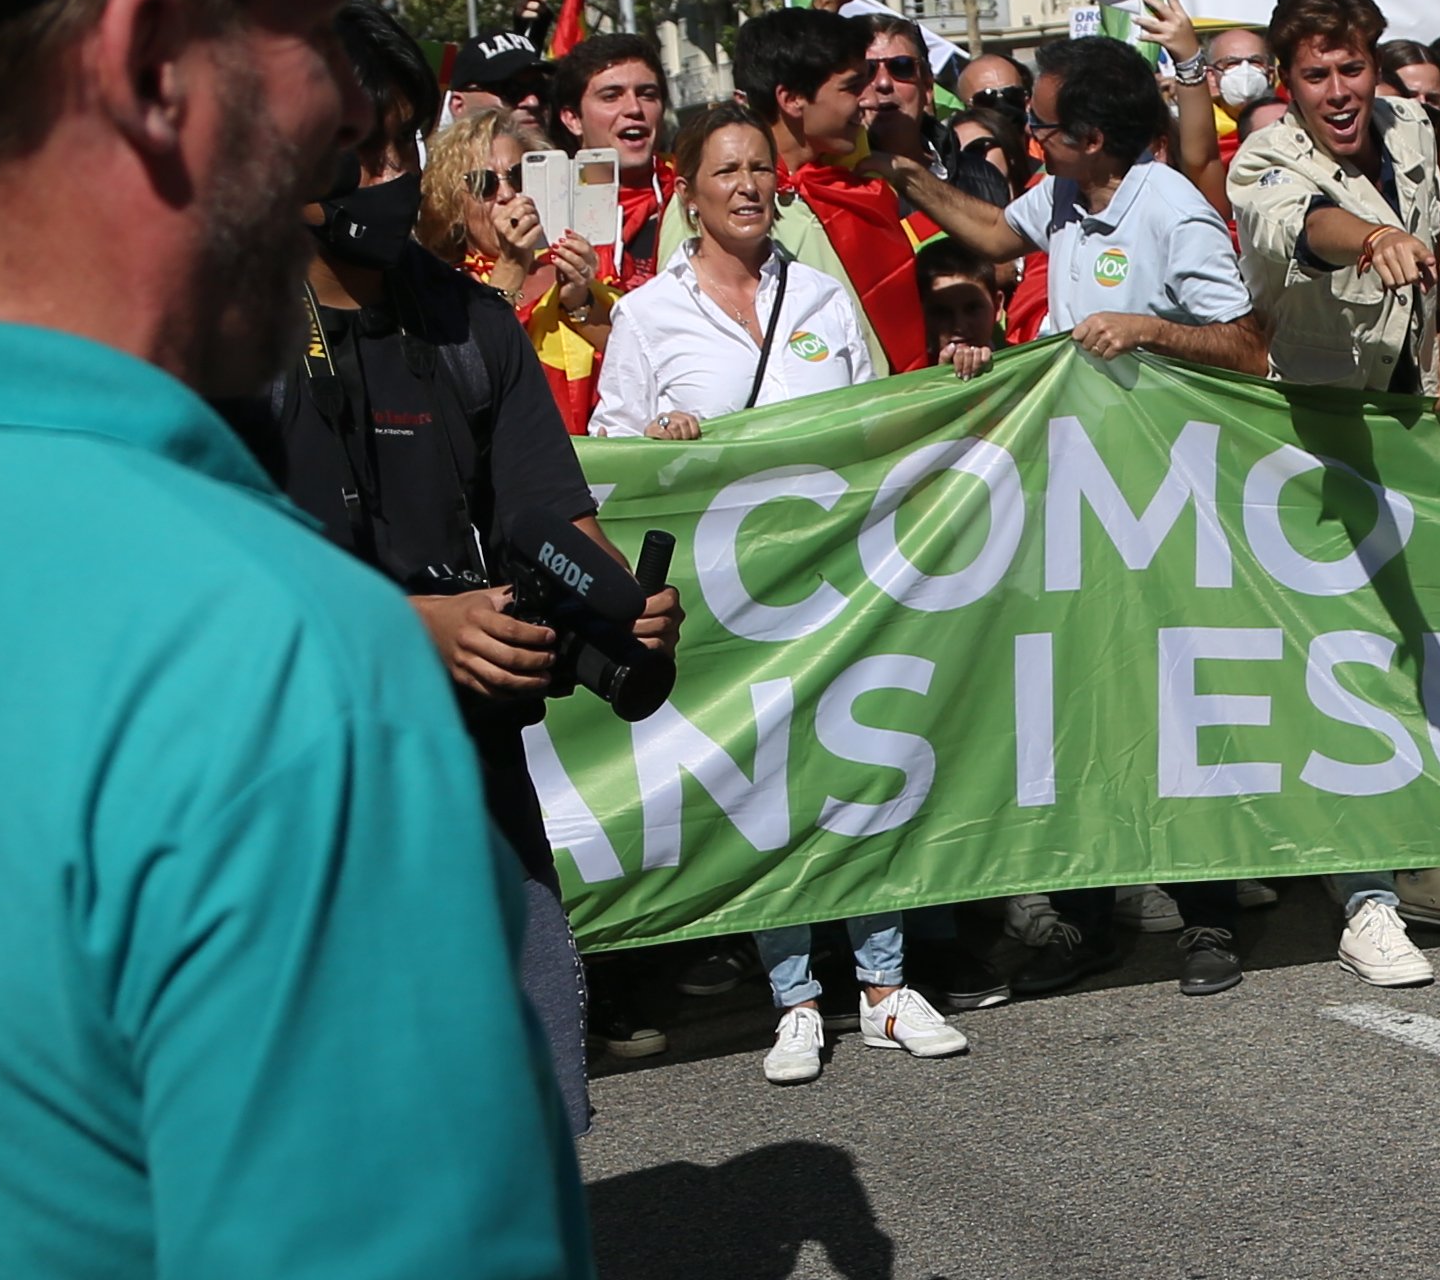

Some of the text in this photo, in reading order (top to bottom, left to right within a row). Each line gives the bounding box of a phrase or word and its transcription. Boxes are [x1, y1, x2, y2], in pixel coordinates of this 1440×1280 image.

[478, 32, 536, 60] LAPD
[1096, 257, 1128, 277] VOX
[792, 336, 827, 357] VOX
[693, 416, 1414, 642] COMO
[538, 541, 594, 597] RØDE
[1014, 632, 1056, 807] I
